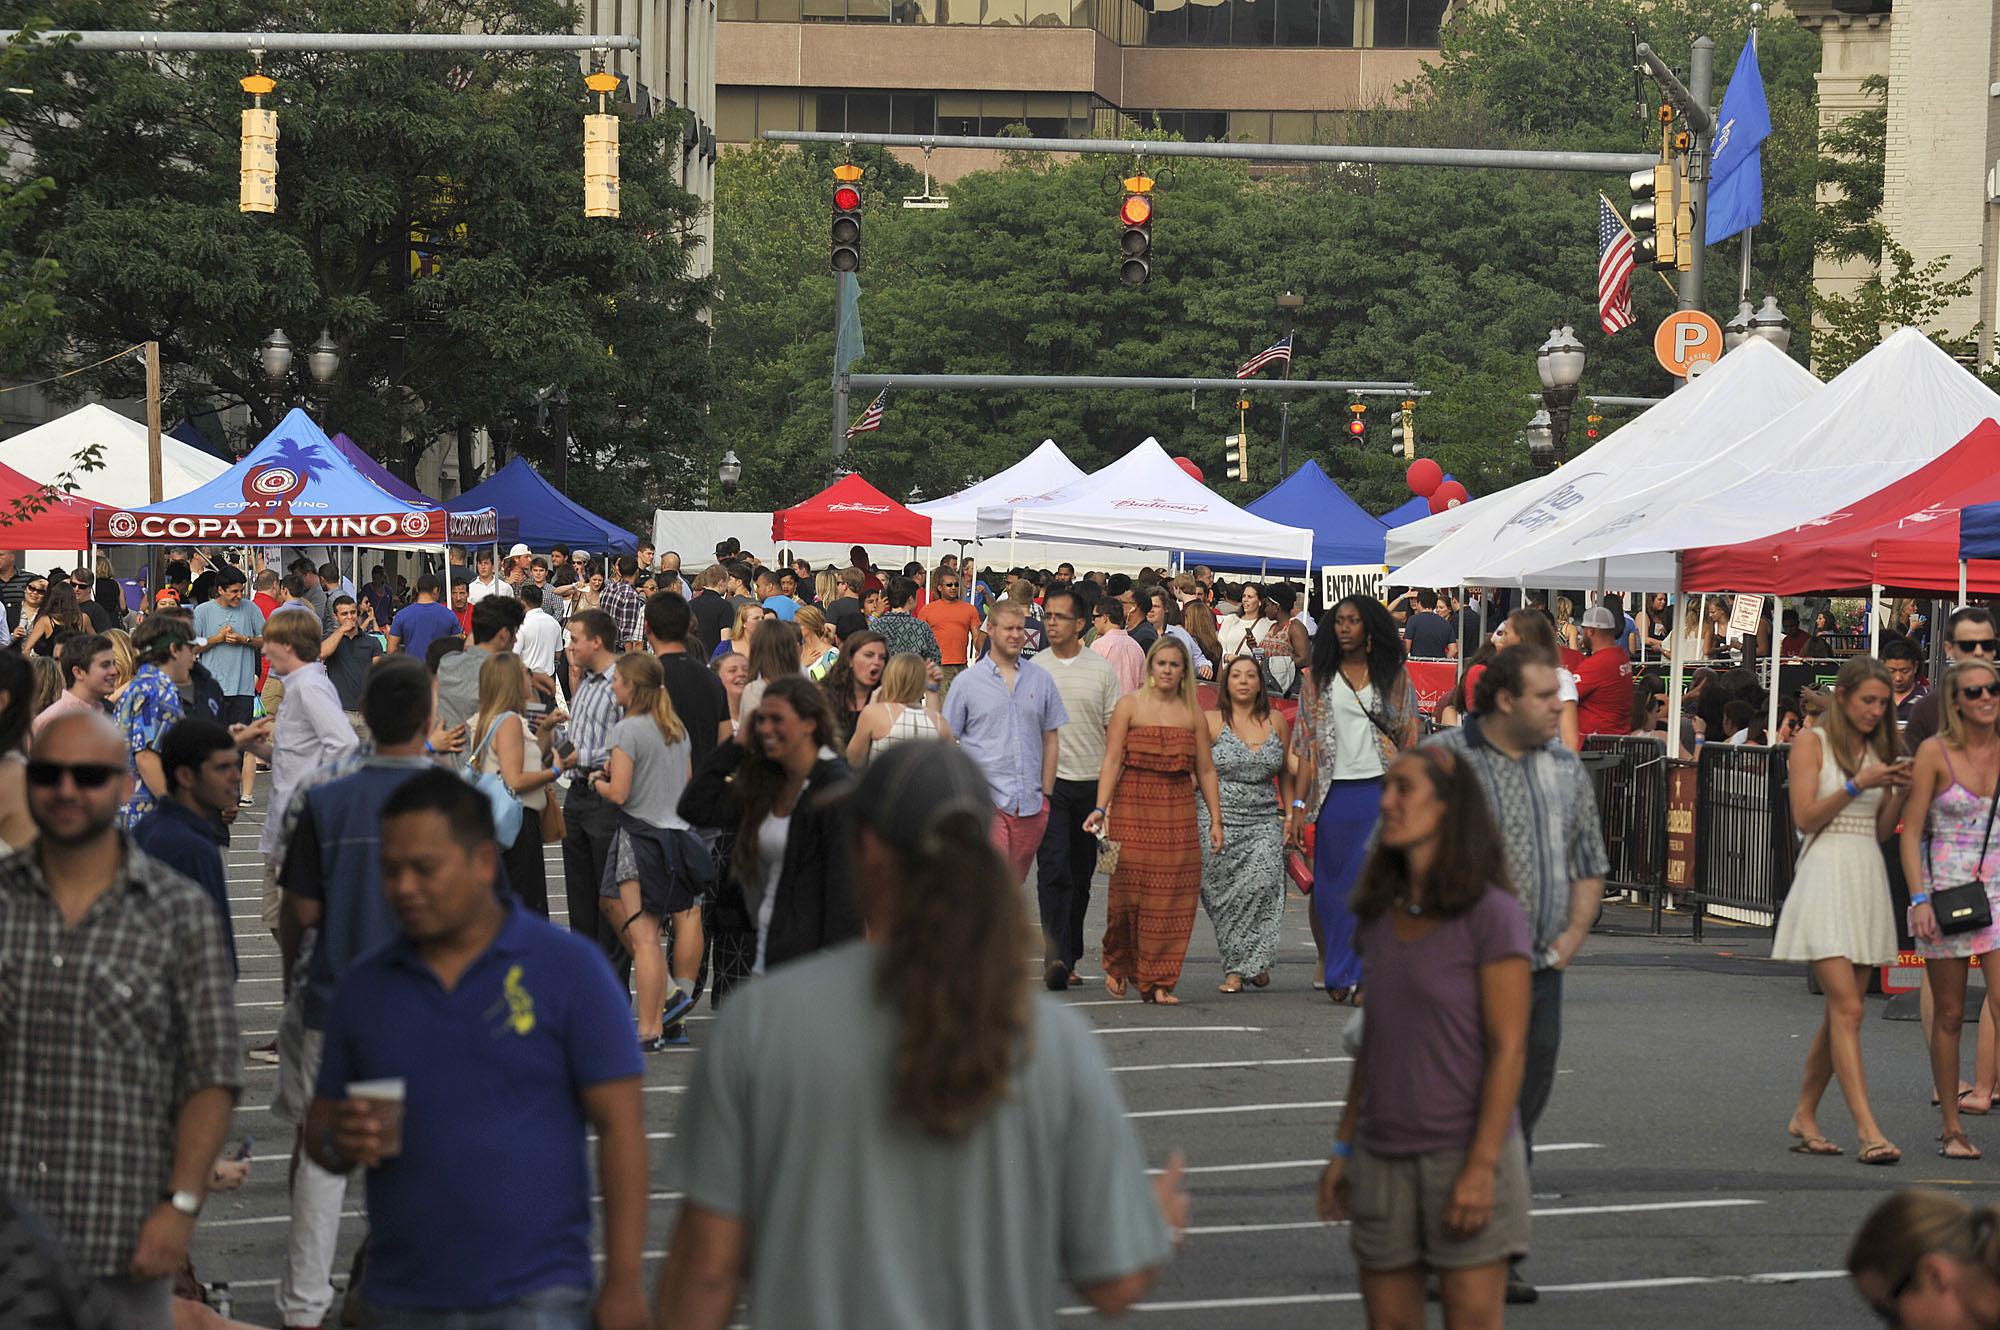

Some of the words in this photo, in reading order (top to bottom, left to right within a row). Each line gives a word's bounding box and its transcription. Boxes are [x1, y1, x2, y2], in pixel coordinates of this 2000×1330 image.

[1674, 322, 1708, 363] P
[140, 516, 246, 538] COPA
[257, 517, 293, 538] DI
[303, 515, 397, 537] VINO
[1326, 573, 1384, 602] ENTRANCE
